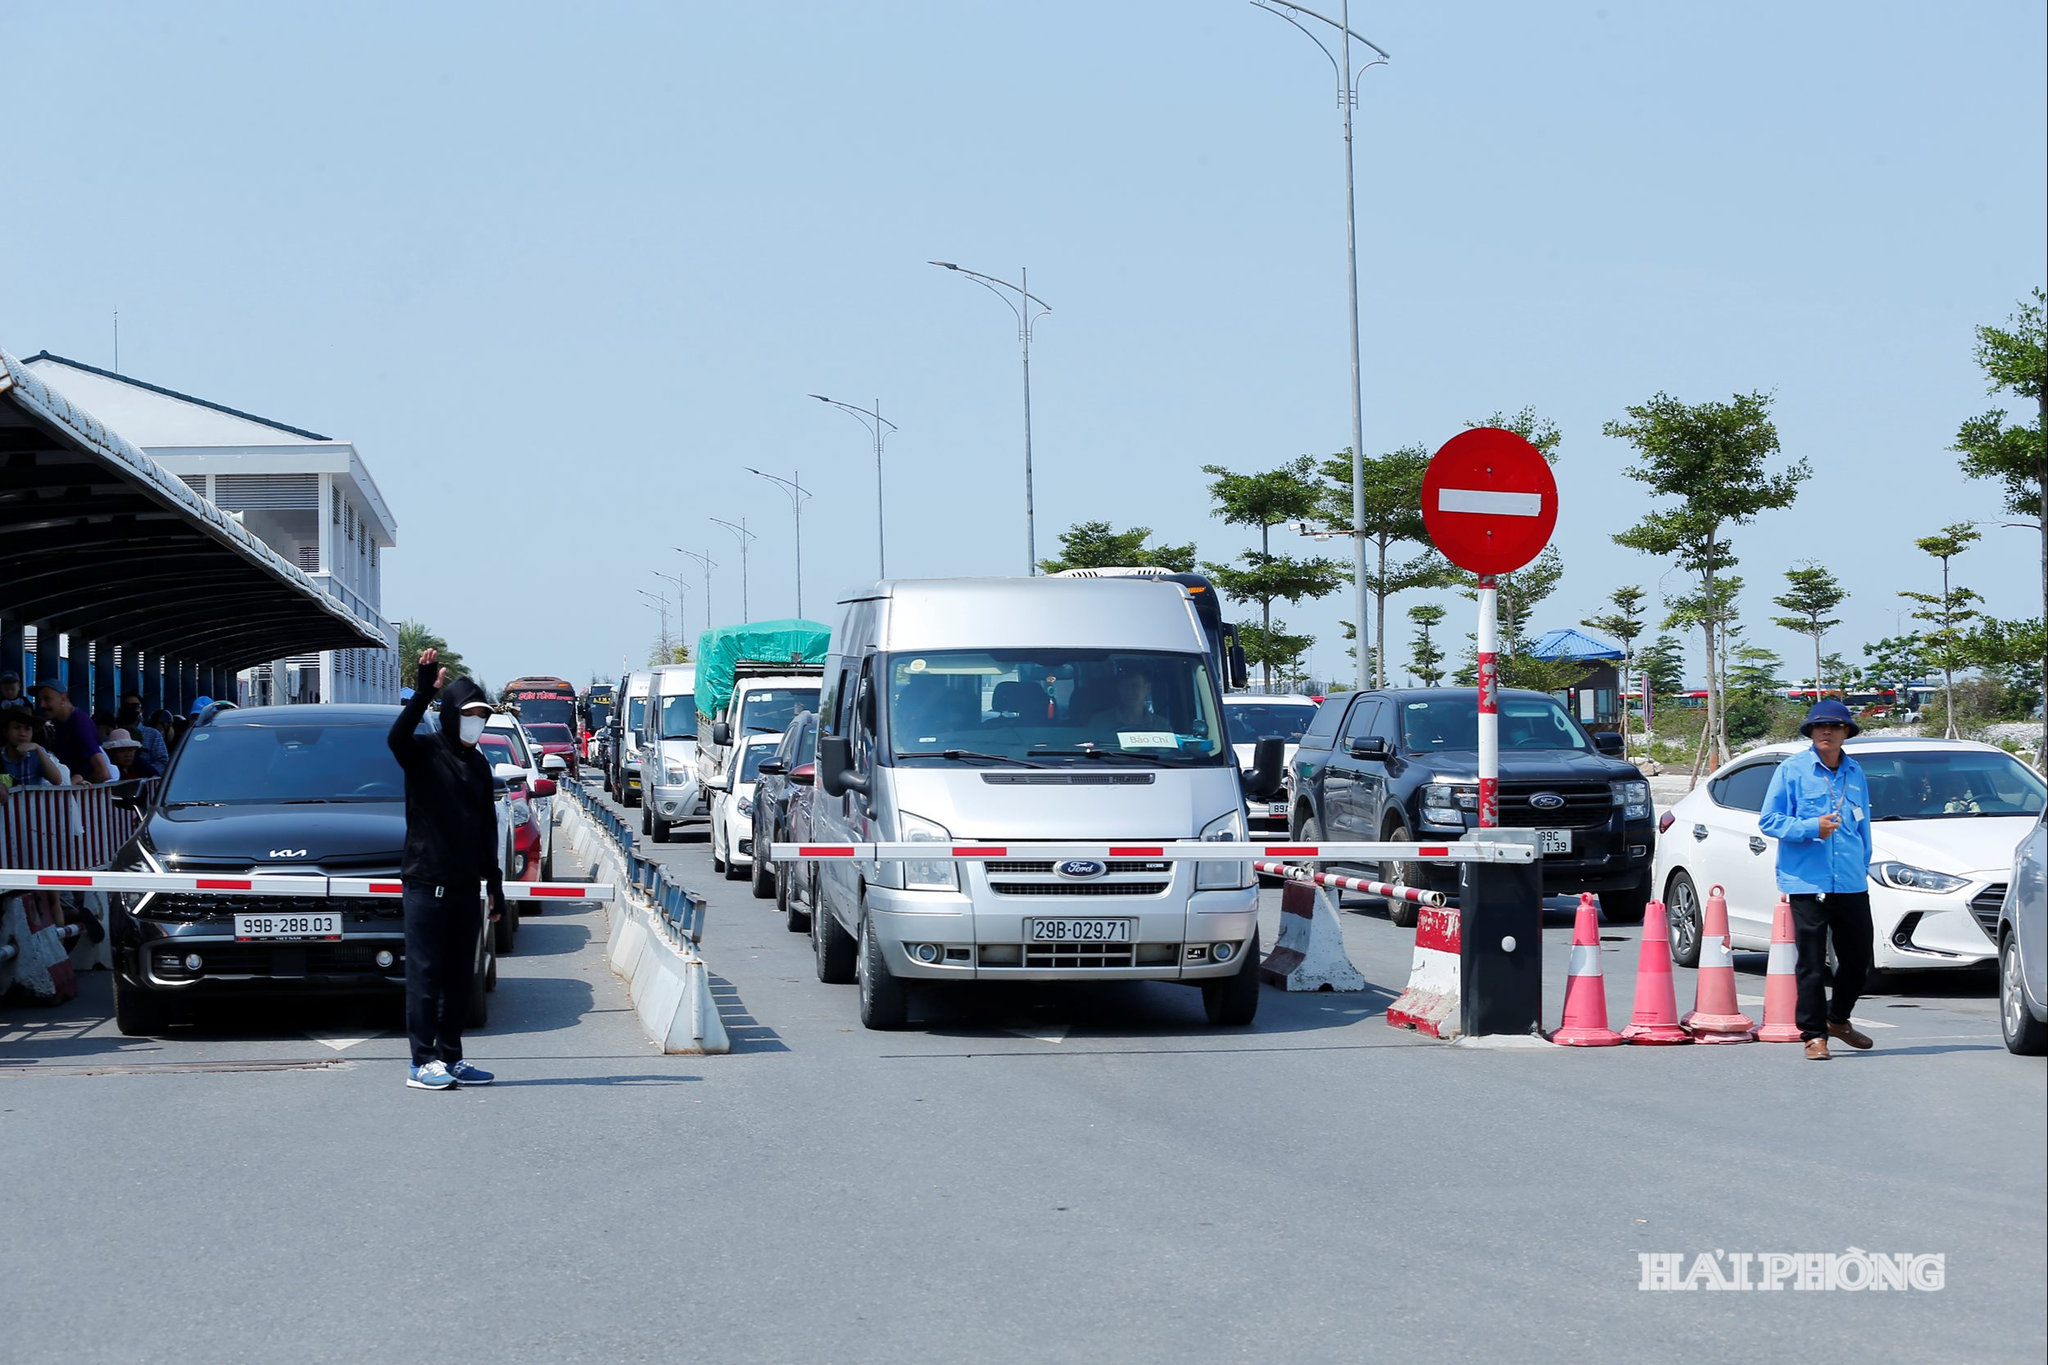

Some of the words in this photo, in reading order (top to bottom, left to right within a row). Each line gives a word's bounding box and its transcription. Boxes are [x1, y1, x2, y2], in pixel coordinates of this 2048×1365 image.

[1152, 735, 1169, 744] Chí
[1542, 841, 1567, 852] 1.39
[1067, 860, 1094, 874] Ford
[243, 917, 333, 934] 99B-288.03
[1035, 921, 1127, 940] 29B-029.71
